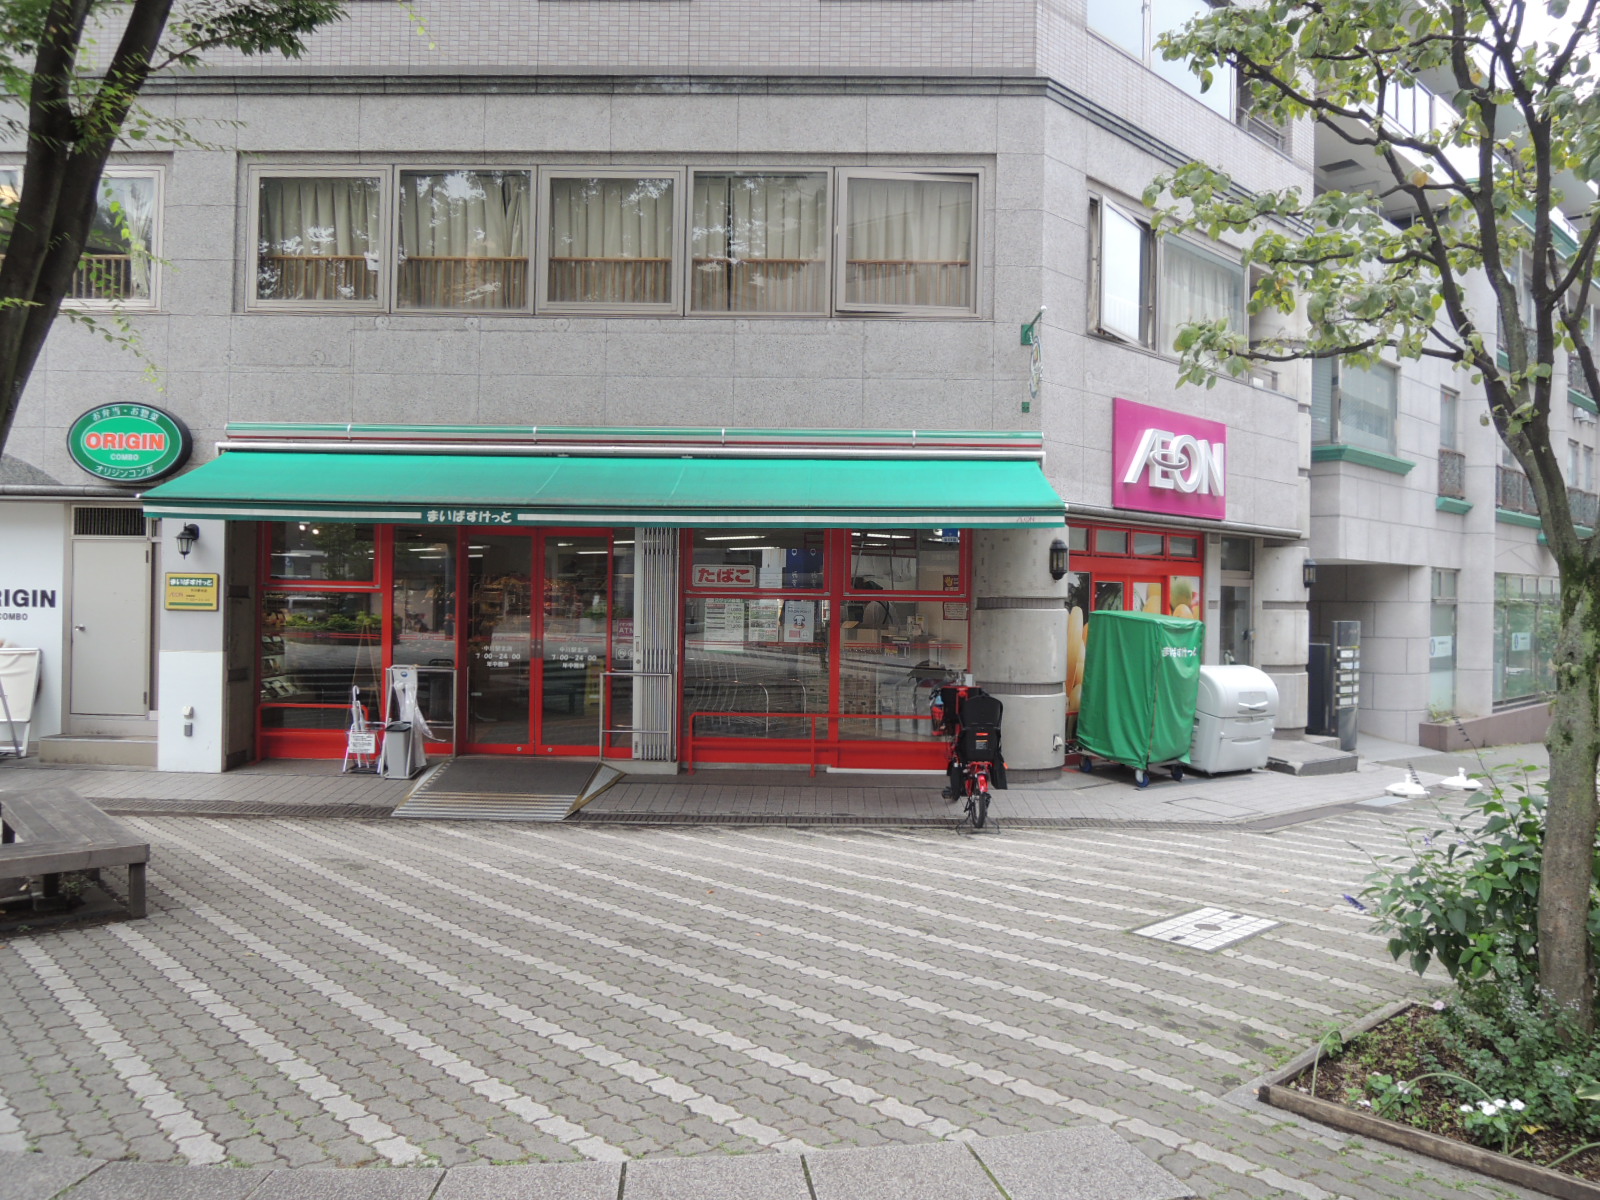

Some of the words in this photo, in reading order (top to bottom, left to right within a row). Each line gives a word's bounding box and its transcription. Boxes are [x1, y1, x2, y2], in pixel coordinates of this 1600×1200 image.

[85, 432, 166, 451] ORIGIN
[110, 453, 139, 461] COMBO
[1123, 428, 1224, 497] AEON
[427, 510, 512, 523] まいばすけっと
[170, 578, 213, 586] まいばすけっと
[698, 568, 751, 583] たばこ
